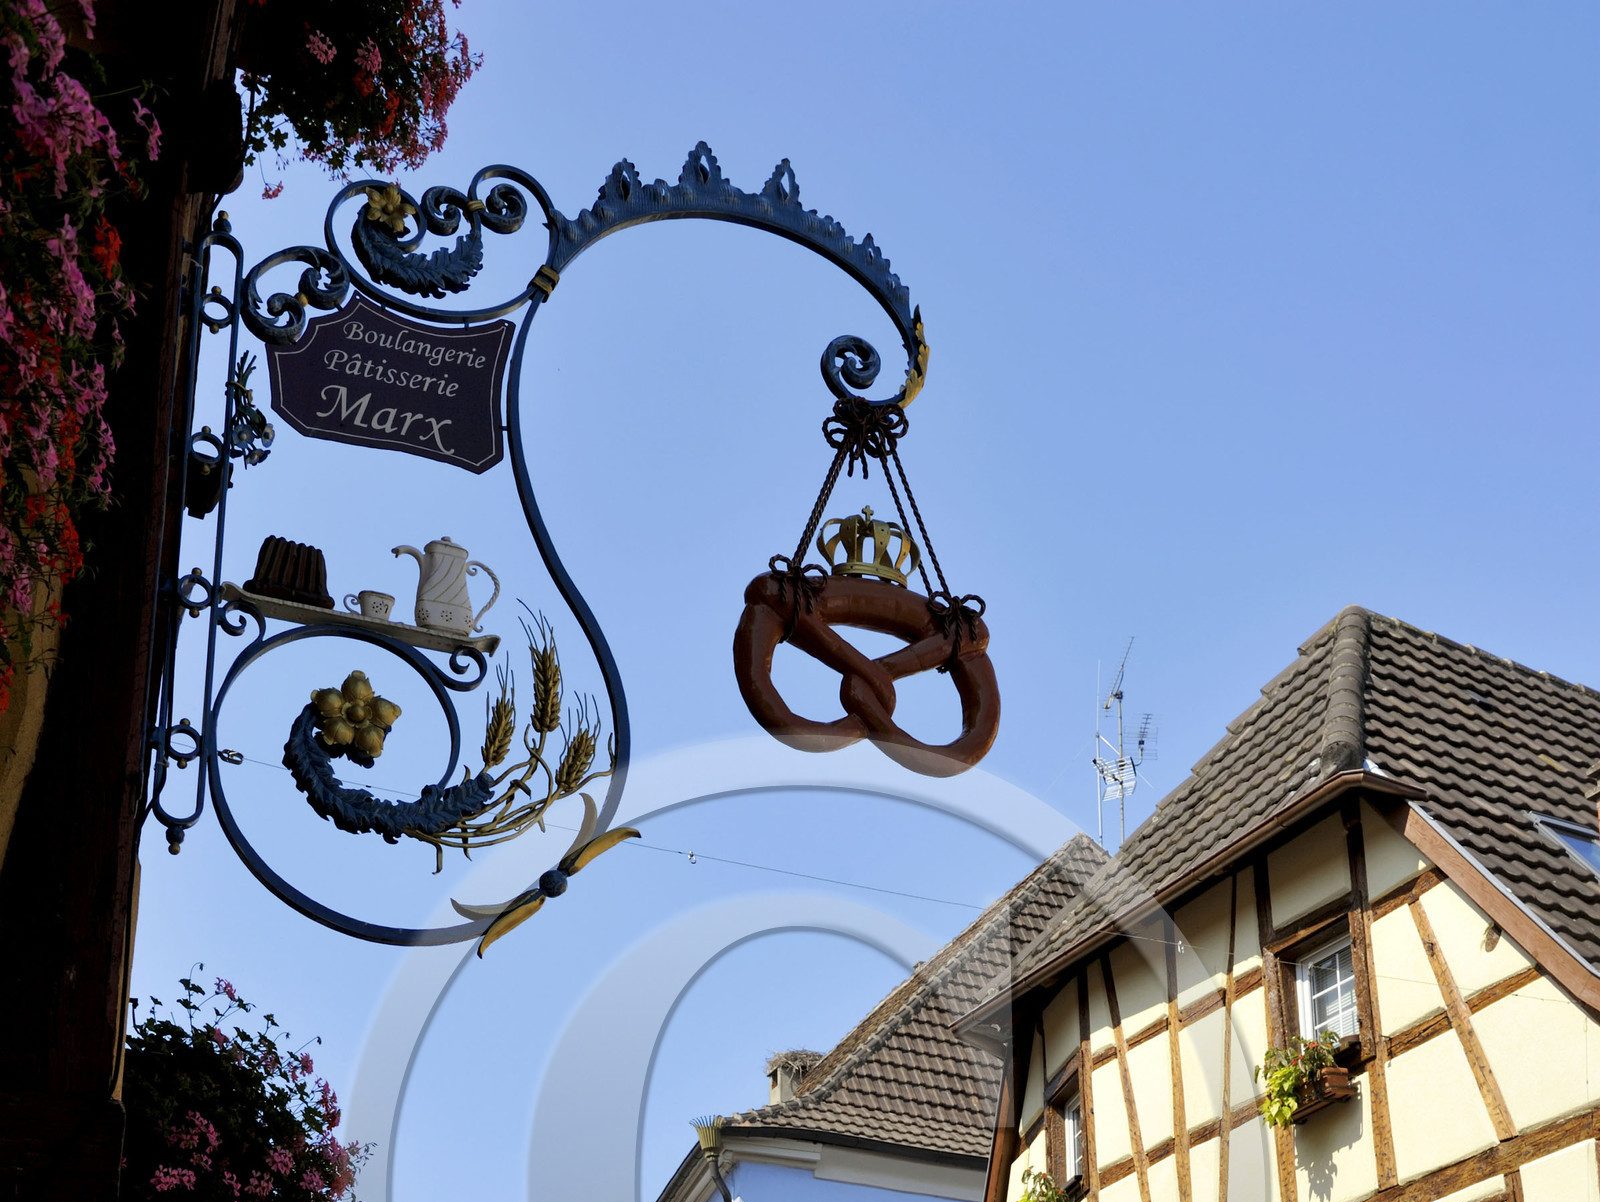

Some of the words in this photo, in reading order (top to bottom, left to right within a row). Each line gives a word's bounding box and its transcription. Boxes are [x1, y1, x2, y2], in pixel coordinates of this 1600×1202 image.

[343, 321, 486, 368] Boulangerie
[324, 350, 459, 397] Pâtisserie
[316, 385, 455, 454] Marx
